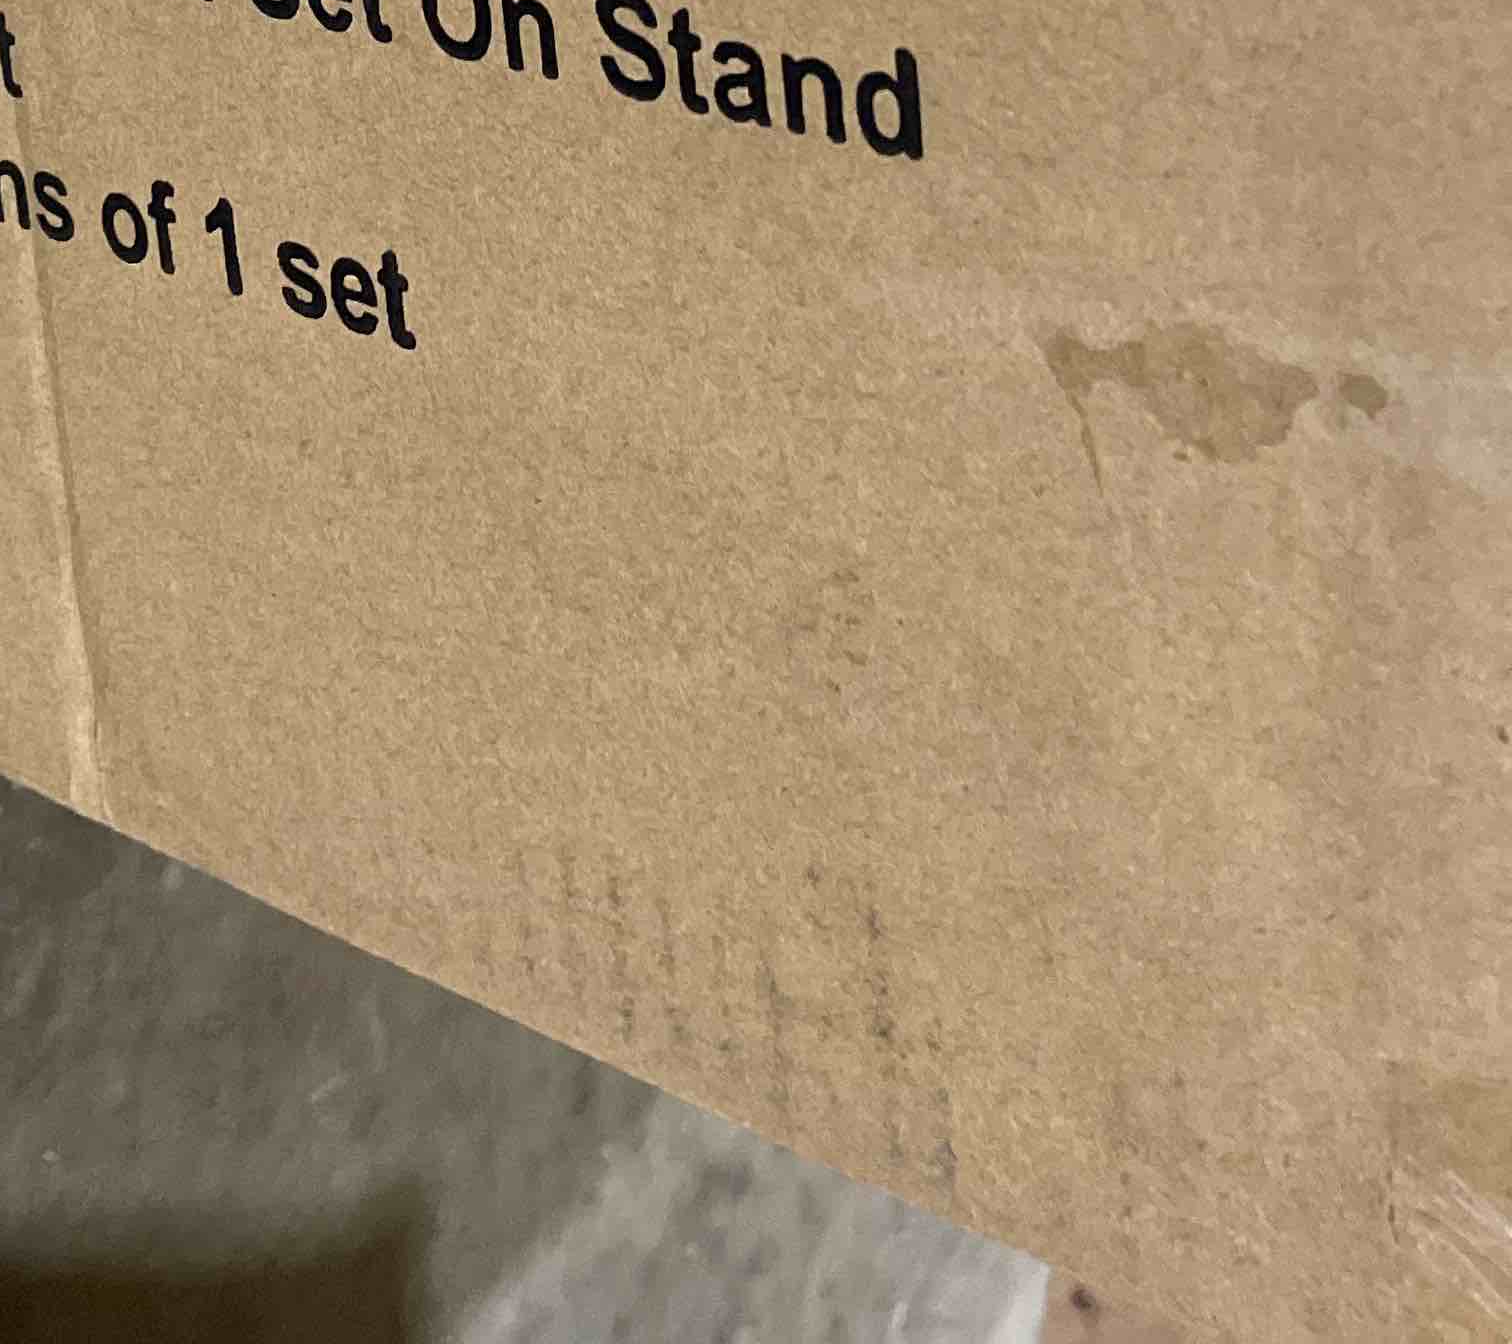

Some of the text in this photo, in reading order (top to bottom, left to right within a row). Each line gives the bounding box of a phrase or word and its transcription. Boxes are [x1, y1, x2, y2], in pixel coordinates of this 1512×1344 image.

[102, 179, 176, 275] of
[205, 197, 243, 297] 1
[277, 238, 416, 351] set
